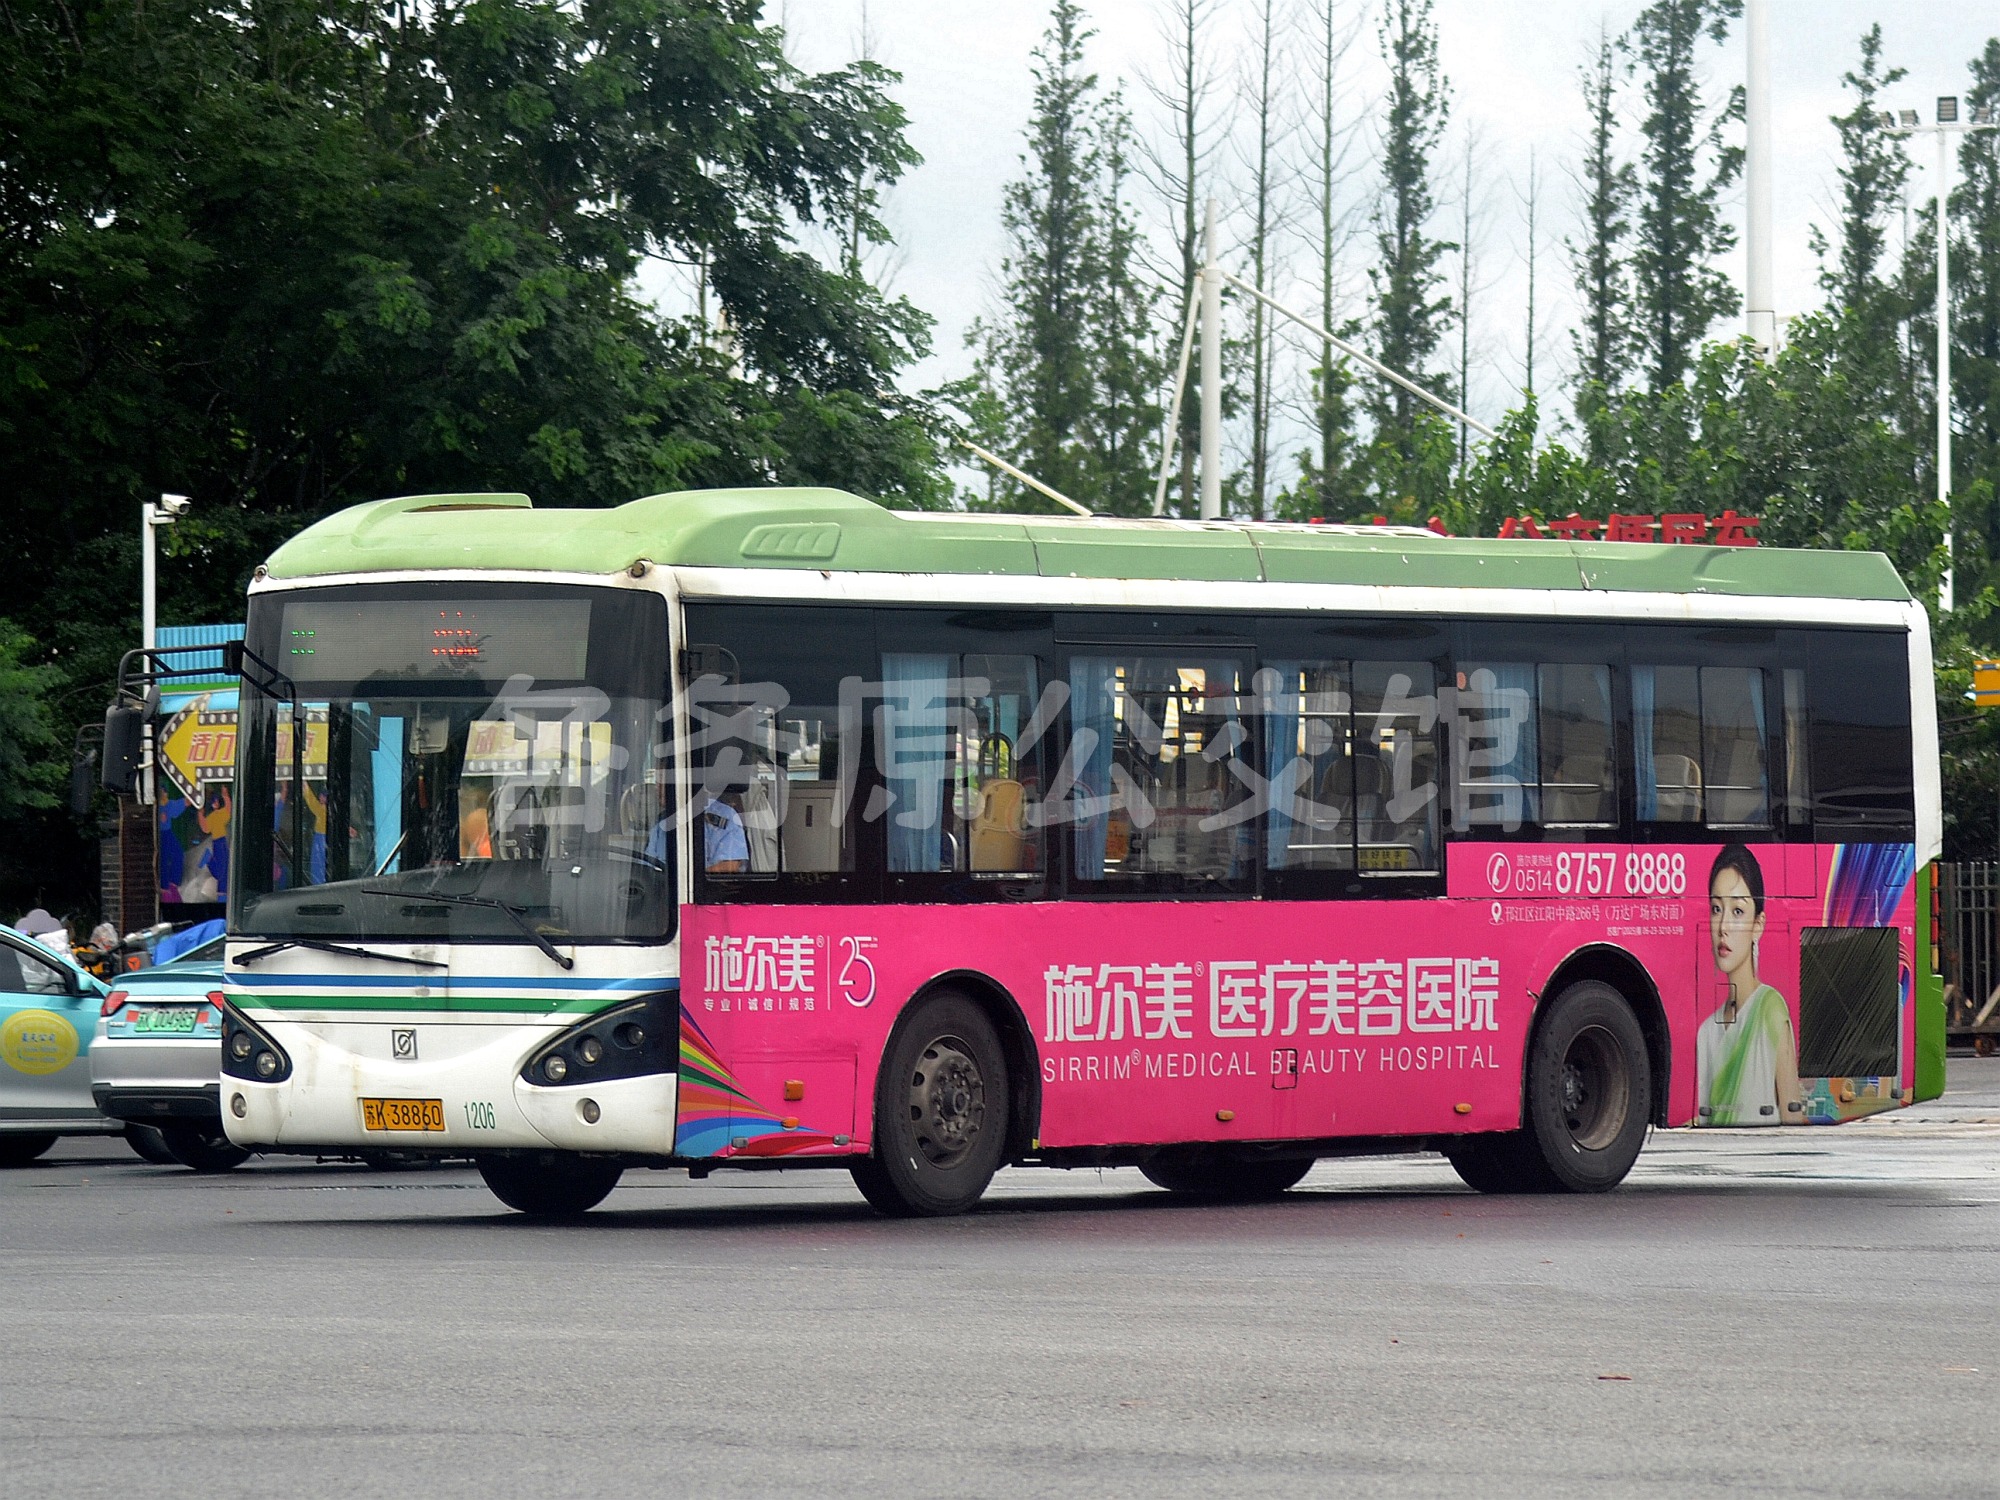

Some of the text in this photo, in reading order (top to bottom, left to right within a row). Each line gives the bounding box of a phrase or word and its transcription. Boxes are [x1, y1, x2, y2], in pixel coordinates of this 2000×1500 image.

[1515, 851, 1686, 895] 0514 8757 8888
[1145, 1051, 1257, 1079] MEDICAL
[1269, 1048, 1368, 1075] BEAUTY
[1379, 1045, 1500, 1073] HOSPITAL
[463, 1101, 496, 1130] 1206
